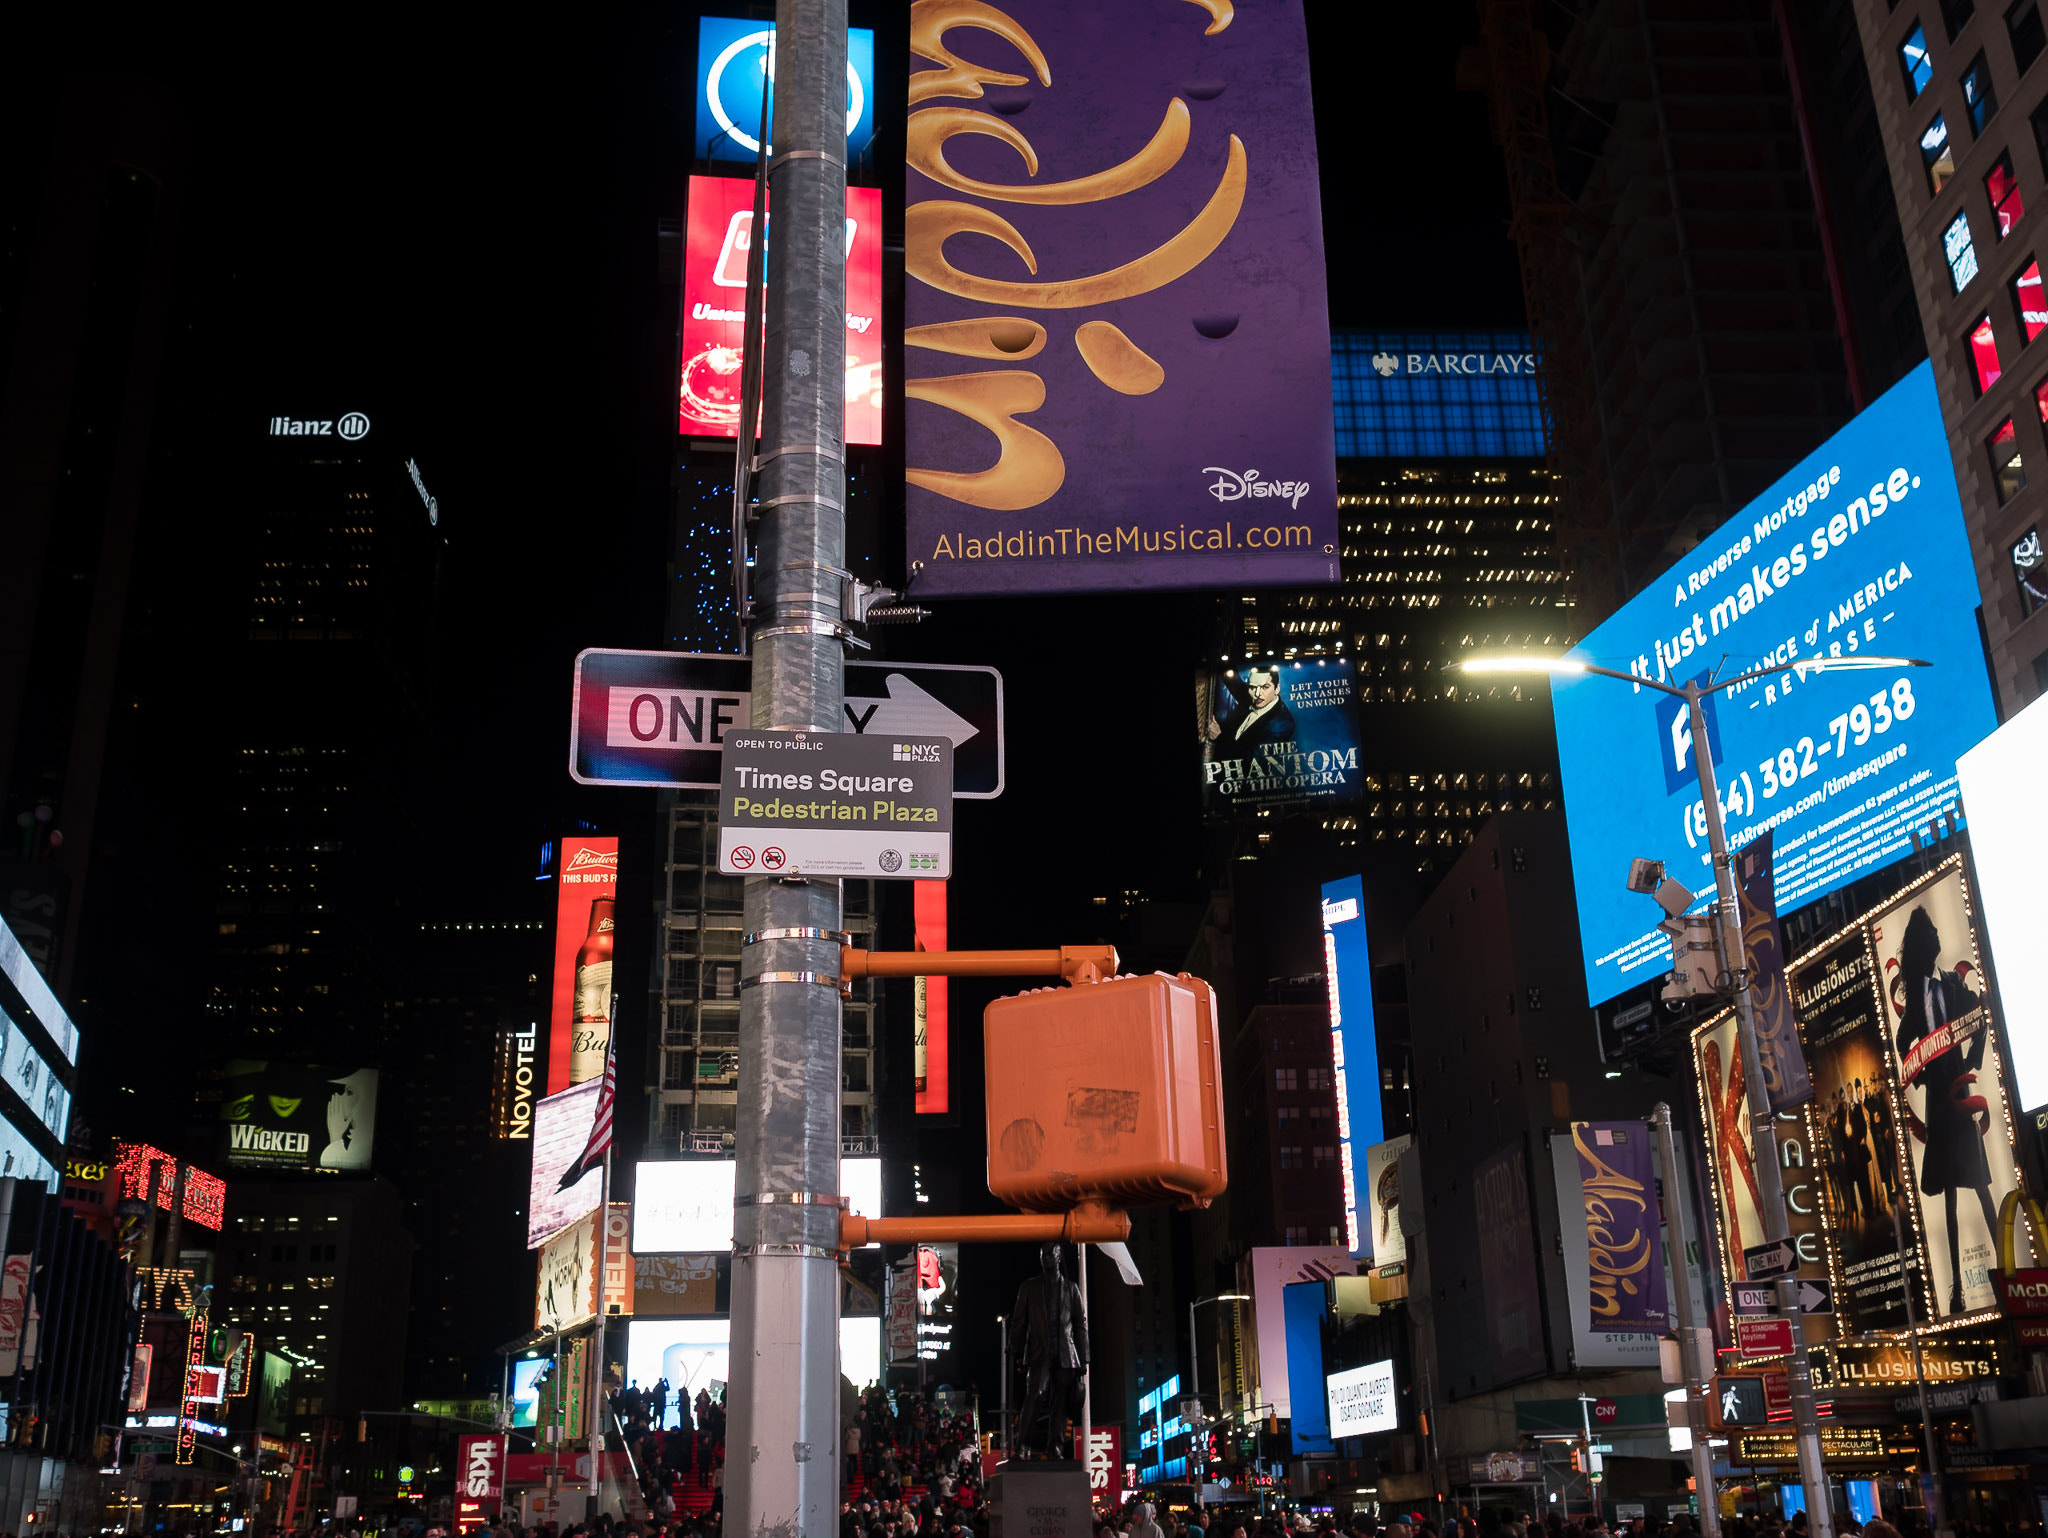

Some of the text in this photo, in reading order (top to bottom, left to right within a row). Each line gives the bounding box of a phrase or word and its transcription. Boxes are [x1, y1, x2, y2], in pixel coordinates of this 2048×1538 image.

[1407, 354, 1536, 374] BARCLAYS
[270, 417, 332, 435] lianz
[408, 457, 430, 508] Allianz
[1202, 466, 1310, 509] Disney
[932, 522, 1312, 560] AladdinTheMusical.com
[1674, 464, 1842, 607] A Reverse Mortgage
[1631, 466, 1921, 694] It just makes sense.
[1804, 619, 1821, 647] of
[1826, 562, 1912, 634] AMERICA
[1289, 687, 1351, 701] FANTASIES
[1290, 679, 1349, 692] LET YOUR
[1297, 697, 1345, 709] UNWIND
[628, 693, 742, 744] ONE
[736, 740, 823, 751] OPEN TO PUBLIC
[912, 744, 940, 756] NYC
[1260, 741, 1298, 756] THE
[1762, 678, 1916, 799] 382-7938
[912, 755, 940, 763] PLAZA
[1203, 747, 1358, 784] PHANTOM
[734, 767, 914, 796] Times Square
[1219, 771, 1346, 795] OF THE OPERA
[733, 797, 938, 822] Pedestrian Plaza
[1702, 743, 1907, 866] w.FARreverse.com/timessquare
[1779, 833, 1807, 856] product
[1806, 828, 1817, 839] for
[1818, 802, 1865, 833] homeowners
[1865, 797, 1876, 809] 62
[1876, 786, 1898, 806] years
[1898, 781, 1908, 792] or
[562, 873, 609, 884] THIS BUD'S
[1825, 959, 1838, 974] THE
[1799, 953, 1869, 1010] ILLUSIONISTS
[1829, 995, 1840, 1007] THE
[1841, 978, 1869, 999] CENTURY
[1826, 1013, 1868, 1042] CLAIRVOYANTS
[1950, 1021, 1960, 1032] SEE
[1903, 1027, 1951, 1082] FINAL MONTHS
[509, 1022, 536, 1139] NOVOTEL
[604, 1209, 629, 1312] HELLO!
[1750, 1251, 1782, 1269] ONE WAY
[1845, 1247, 1914, 1276] DISCOVER THE GOLDEN OF
[1846, 1263, 1901, 1286] MAGIC WITH AN ALL NEW
[1743, 1291, 1770, 1305] ONE
[1605, 1333, 1660, 1343] STEP INT
[1740, 1323, 1778, 1333] NO STANDING
[1742, 1333, 1766, 1342] Anytime
[1904, 1350, 1930, 1360] TE
[1842, 1360, 1990, 1379] ILLUSIONISTS
[182, 1320, 205, 1448] HERSHEY'S
[570, 1344, 582, 1437] OLIVE GARDEN
[1768, 1383, 1789, 1391] Anytim
[1895, 1385, 1997, 1412] CHANE MONEY ATM
[1595, 1406, 1616, 1417] CNY
[1821, 1440, 1875, 1450] PECTACULAR!
[467, 1439, 498, 1498] tkts
[1089, 1431, 1114, 1489] tkts
[1026, 1506, 1067, 1517] GEORGE
